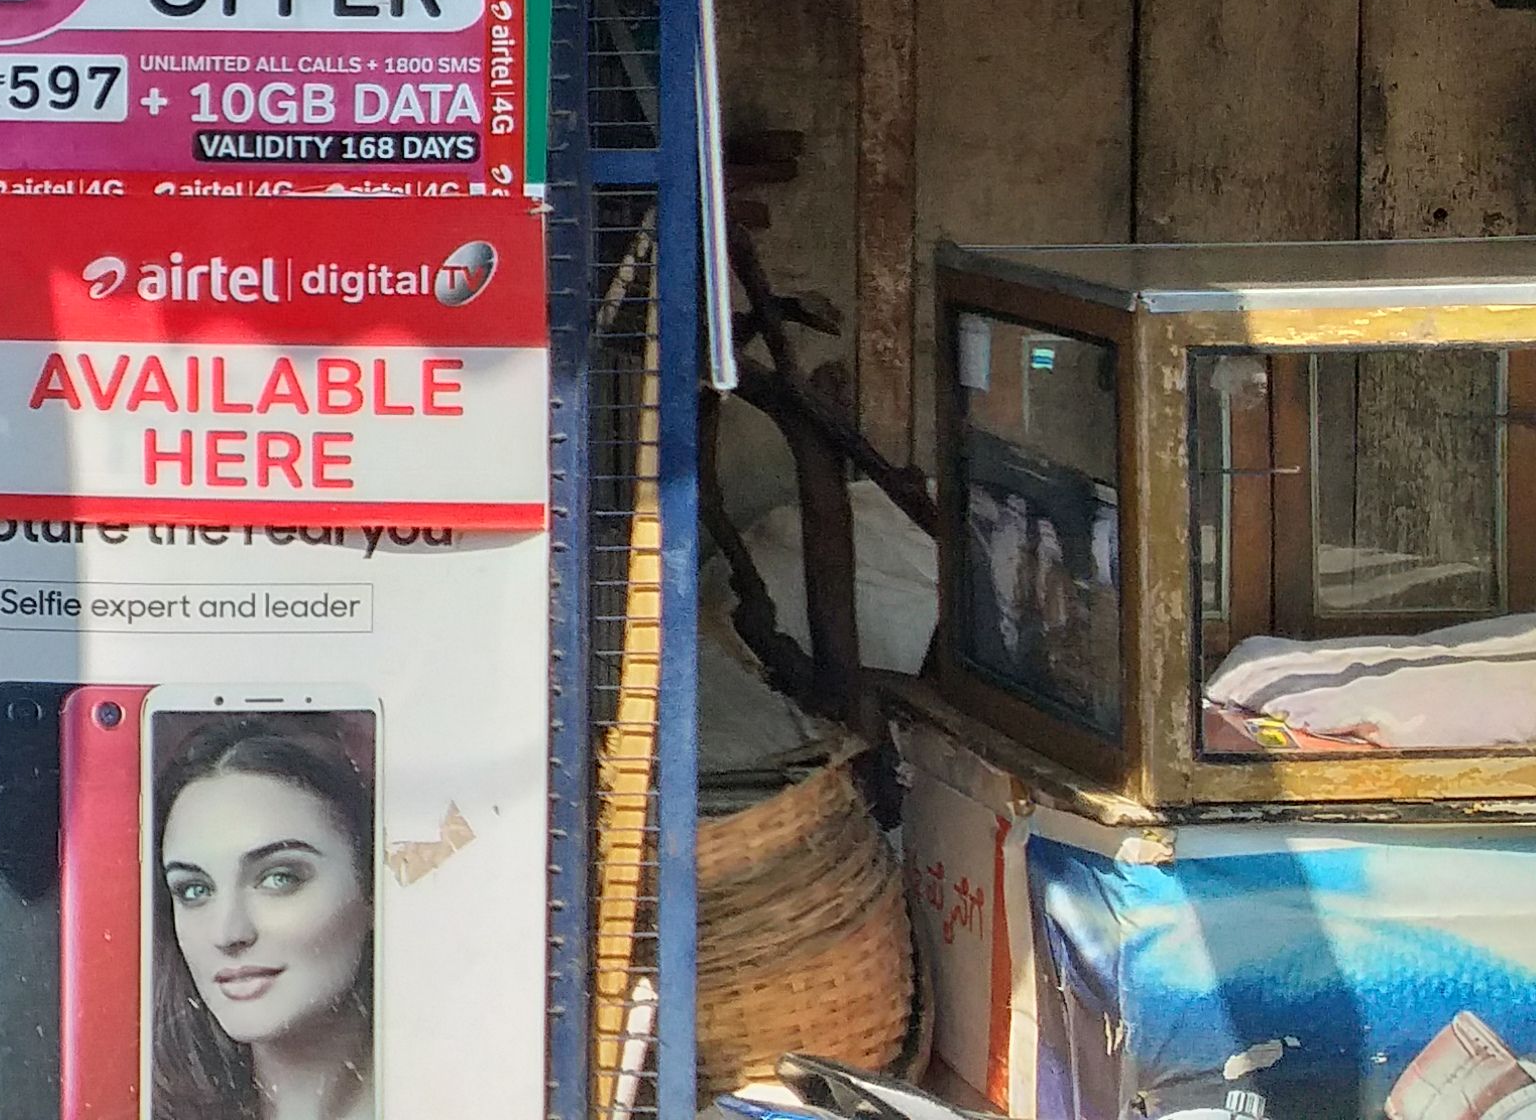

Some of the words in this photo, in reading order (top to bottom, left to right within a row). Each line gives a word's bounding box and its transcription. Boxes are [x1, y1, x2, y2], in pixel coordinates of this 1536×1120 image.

[140, 56, 249, 73] UNLIMITED
[256, 56, 293, 73] ALL
[298, 56, 361, 73] CALLS
[384, 57, 432, 73] 1800
[438, 57, 481, 74] SMS
[140, 87, 168, 116] +
[190, 82, 335, 124] 10GB
[354, 82, 481, 124] DATA
[199, 135, 334, 159] VALIDITY
[342, 136, 394, 159] 168
[403, 136, 475, 160] DAYS
[136, 252, 278, 304] airtel
[301, 260, 430, 308] digital
[28, 355, 466, 417] AVAILABLE
[142, 430, 356, 490] HERE
[0, 588, 81, 620] Selfie
[90, 594, 192, 625] expert
[199, 591, 256, 620] and
[264, 593, 360, 620] leader
